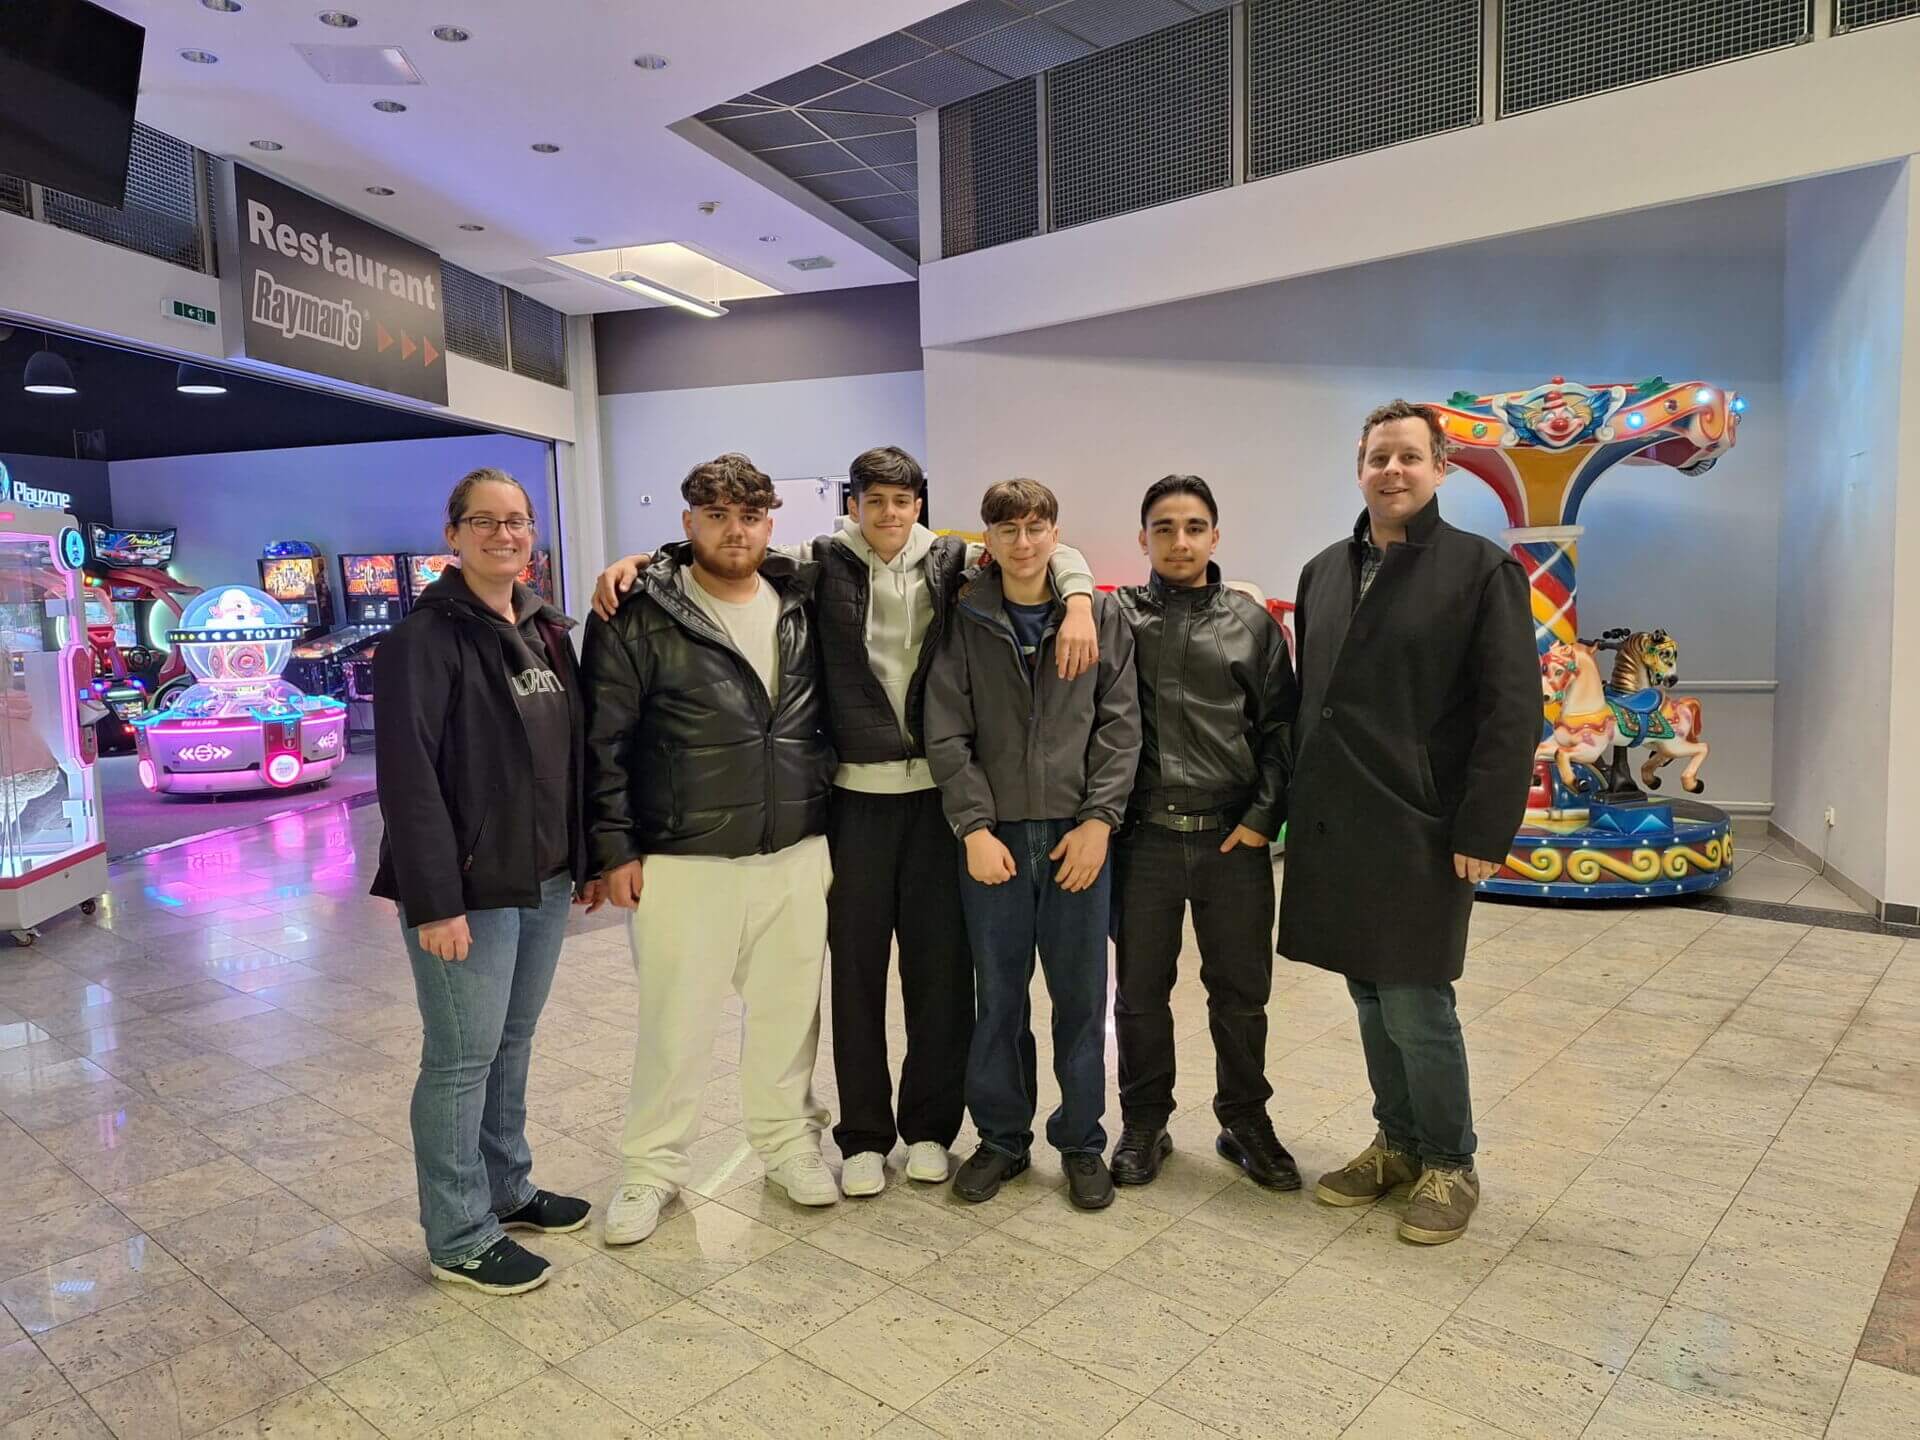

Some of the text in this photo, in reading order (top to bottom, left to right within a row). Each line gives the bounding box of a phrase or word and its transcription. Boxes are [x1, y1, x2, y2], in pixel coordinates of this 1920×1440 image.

[247, 199, 436, 310] Restaurant
[252, 269, 362, 350] Rayman's
[13, 480, 71, 509] Playzone
[242, 629, 276, 640] TOY
